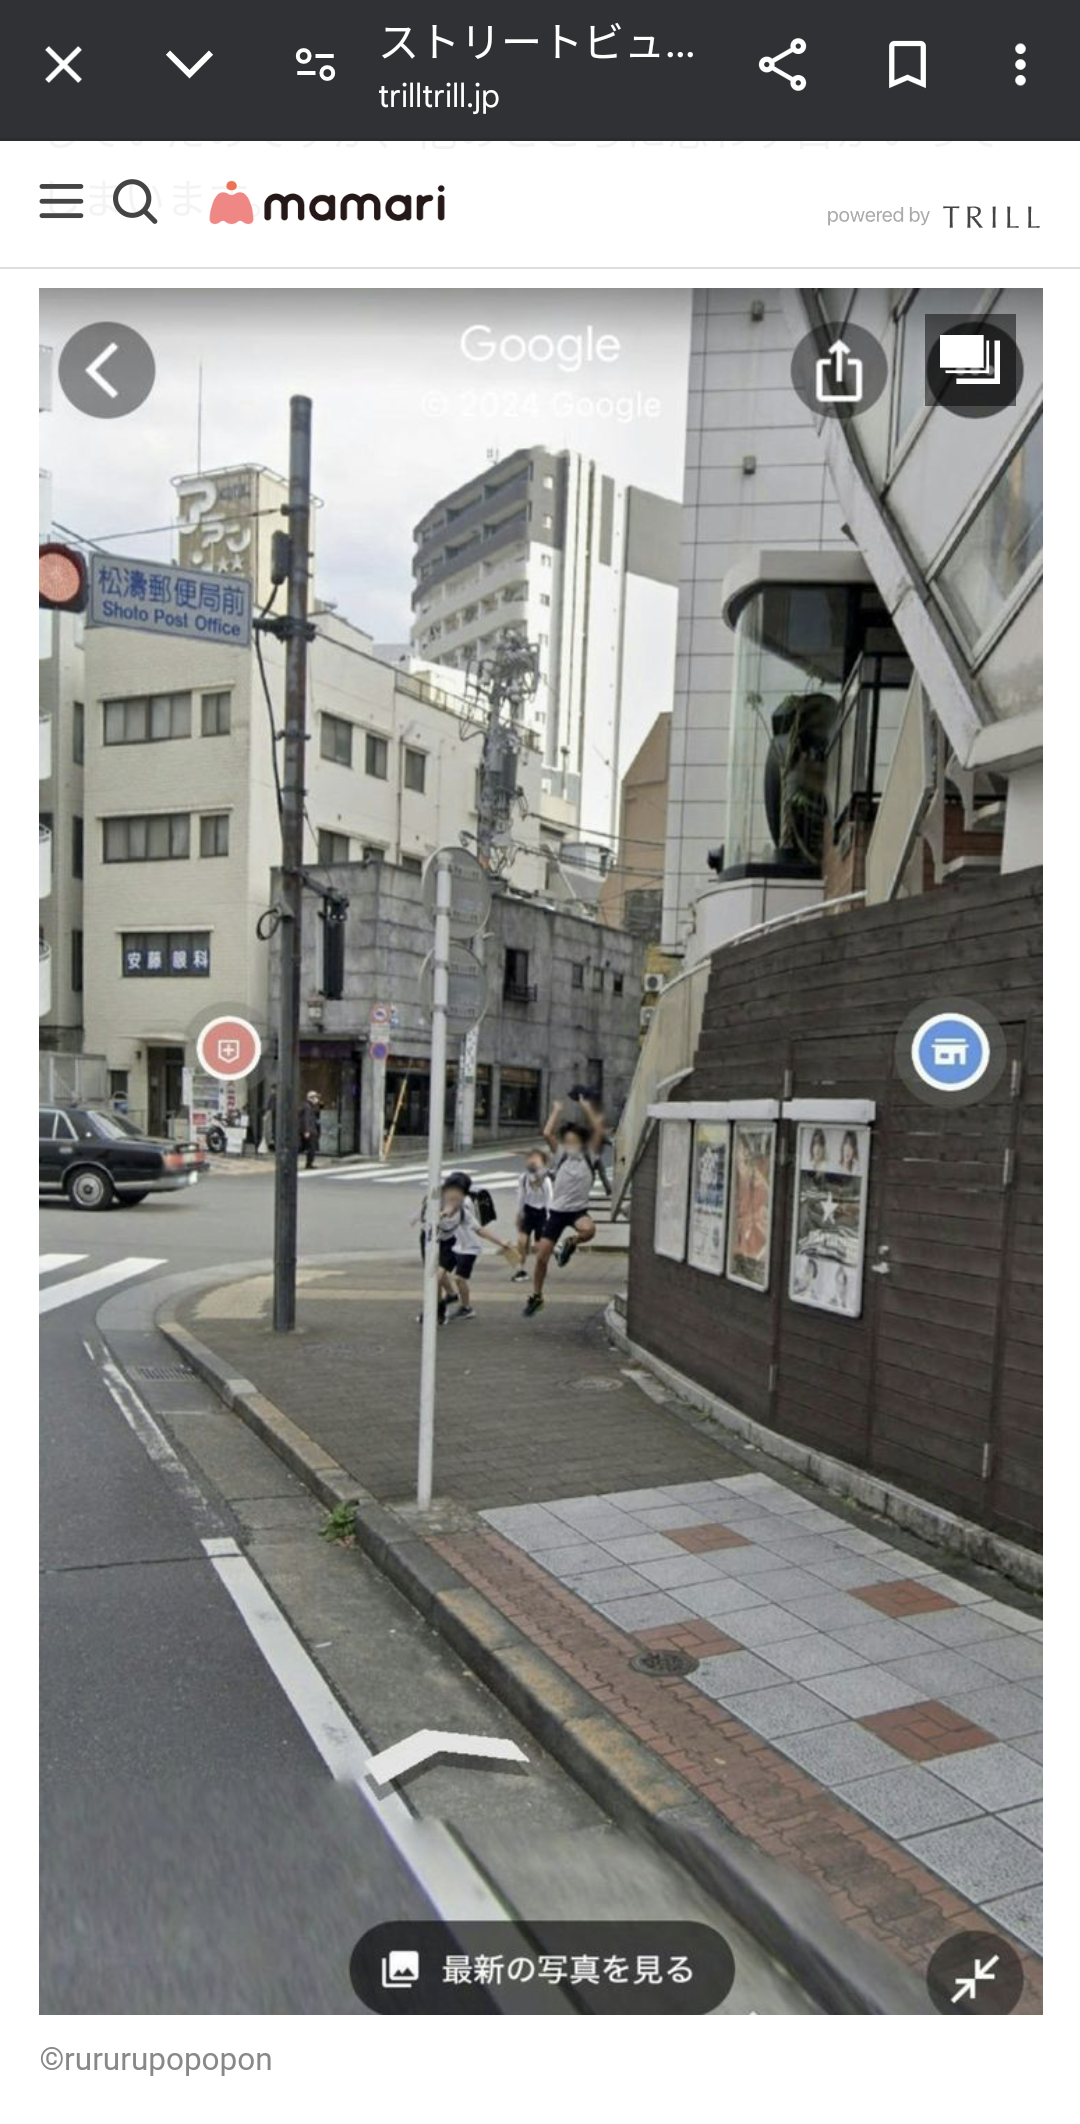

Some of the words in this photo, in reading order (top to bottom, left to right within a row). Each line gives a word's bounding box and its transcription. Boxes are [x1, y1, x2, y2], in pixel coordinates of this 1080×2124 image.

[98, 565, 245, 616] 松濤郵便局前
[103, 600, 149, 622] Shoto
[154, 608, 188, 628] Post
[194, 614, 241, 636] Office
